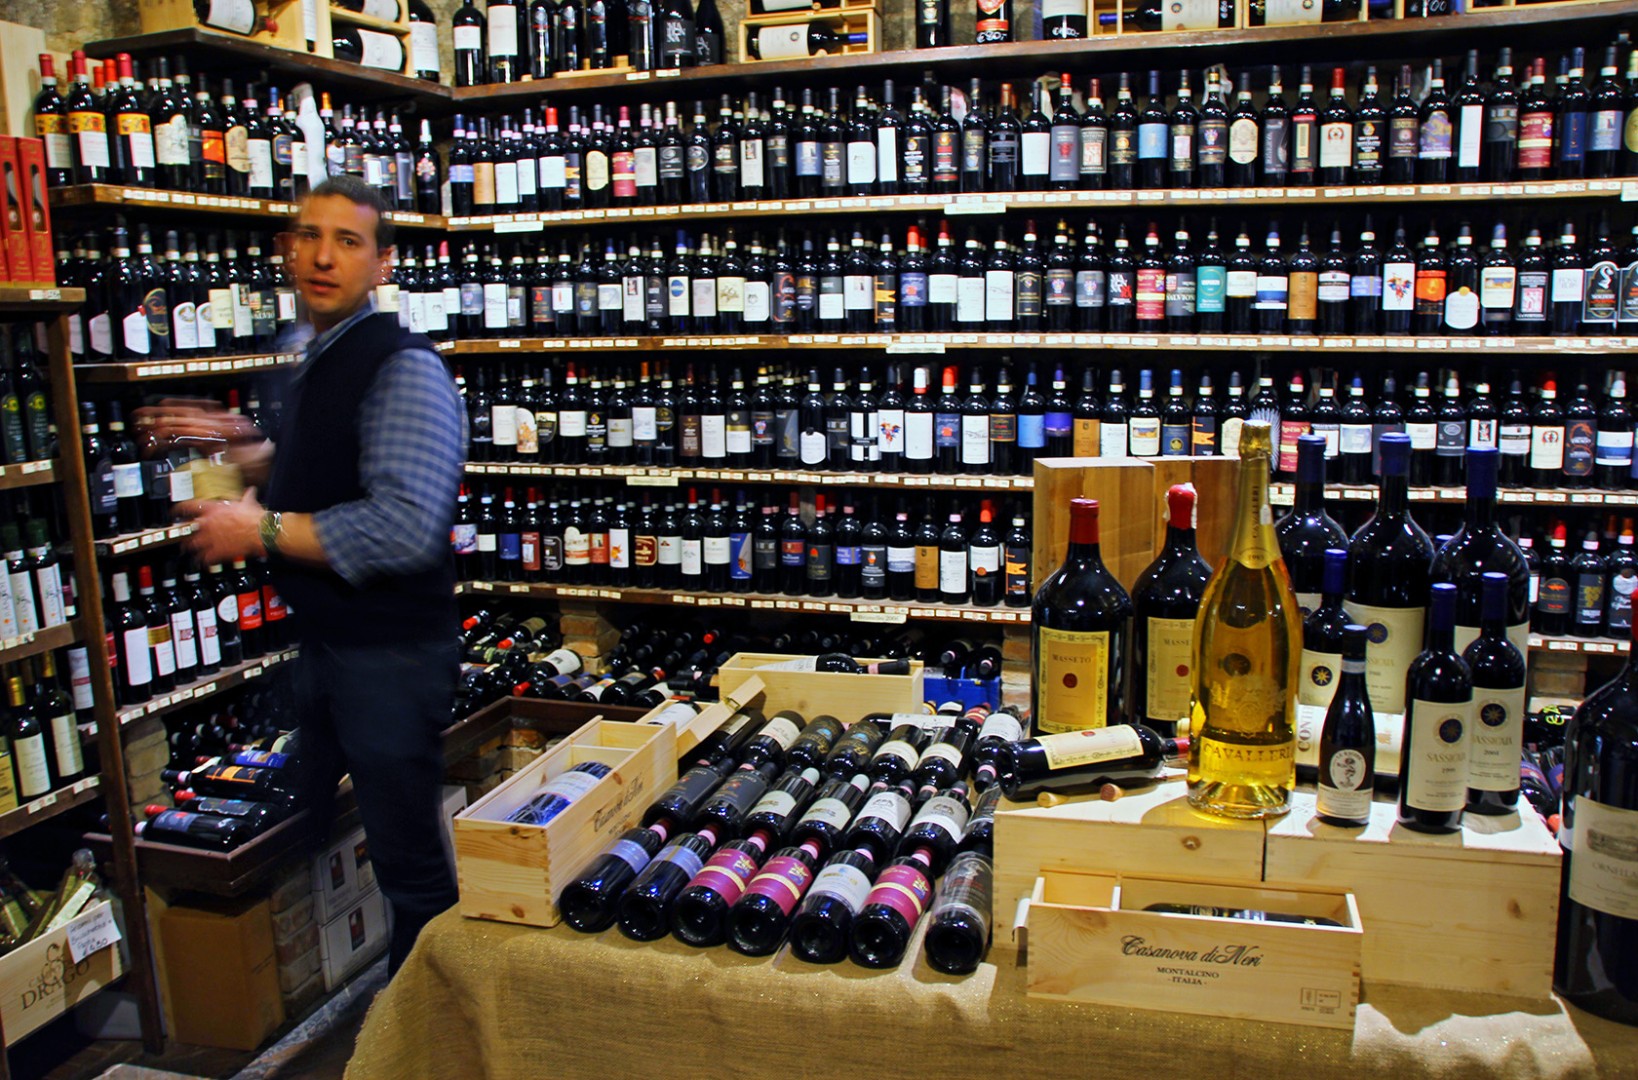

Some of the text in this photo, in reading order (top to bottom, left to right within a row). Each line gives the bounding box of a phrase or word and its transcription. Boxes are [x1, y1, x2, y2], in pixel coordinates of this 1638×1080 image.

[1163, 638, 1190, 646] MASSE
[1052, 654, 1092, 663] MASSETO
[1203, 743, 1291, 761] CAVALLERI
[1121, 935, 1265, 967] Casanova di Neri
[1157, 967, 1220, 978] MONTALCINO
[1172, 976, 1203, 985] ITALIA
